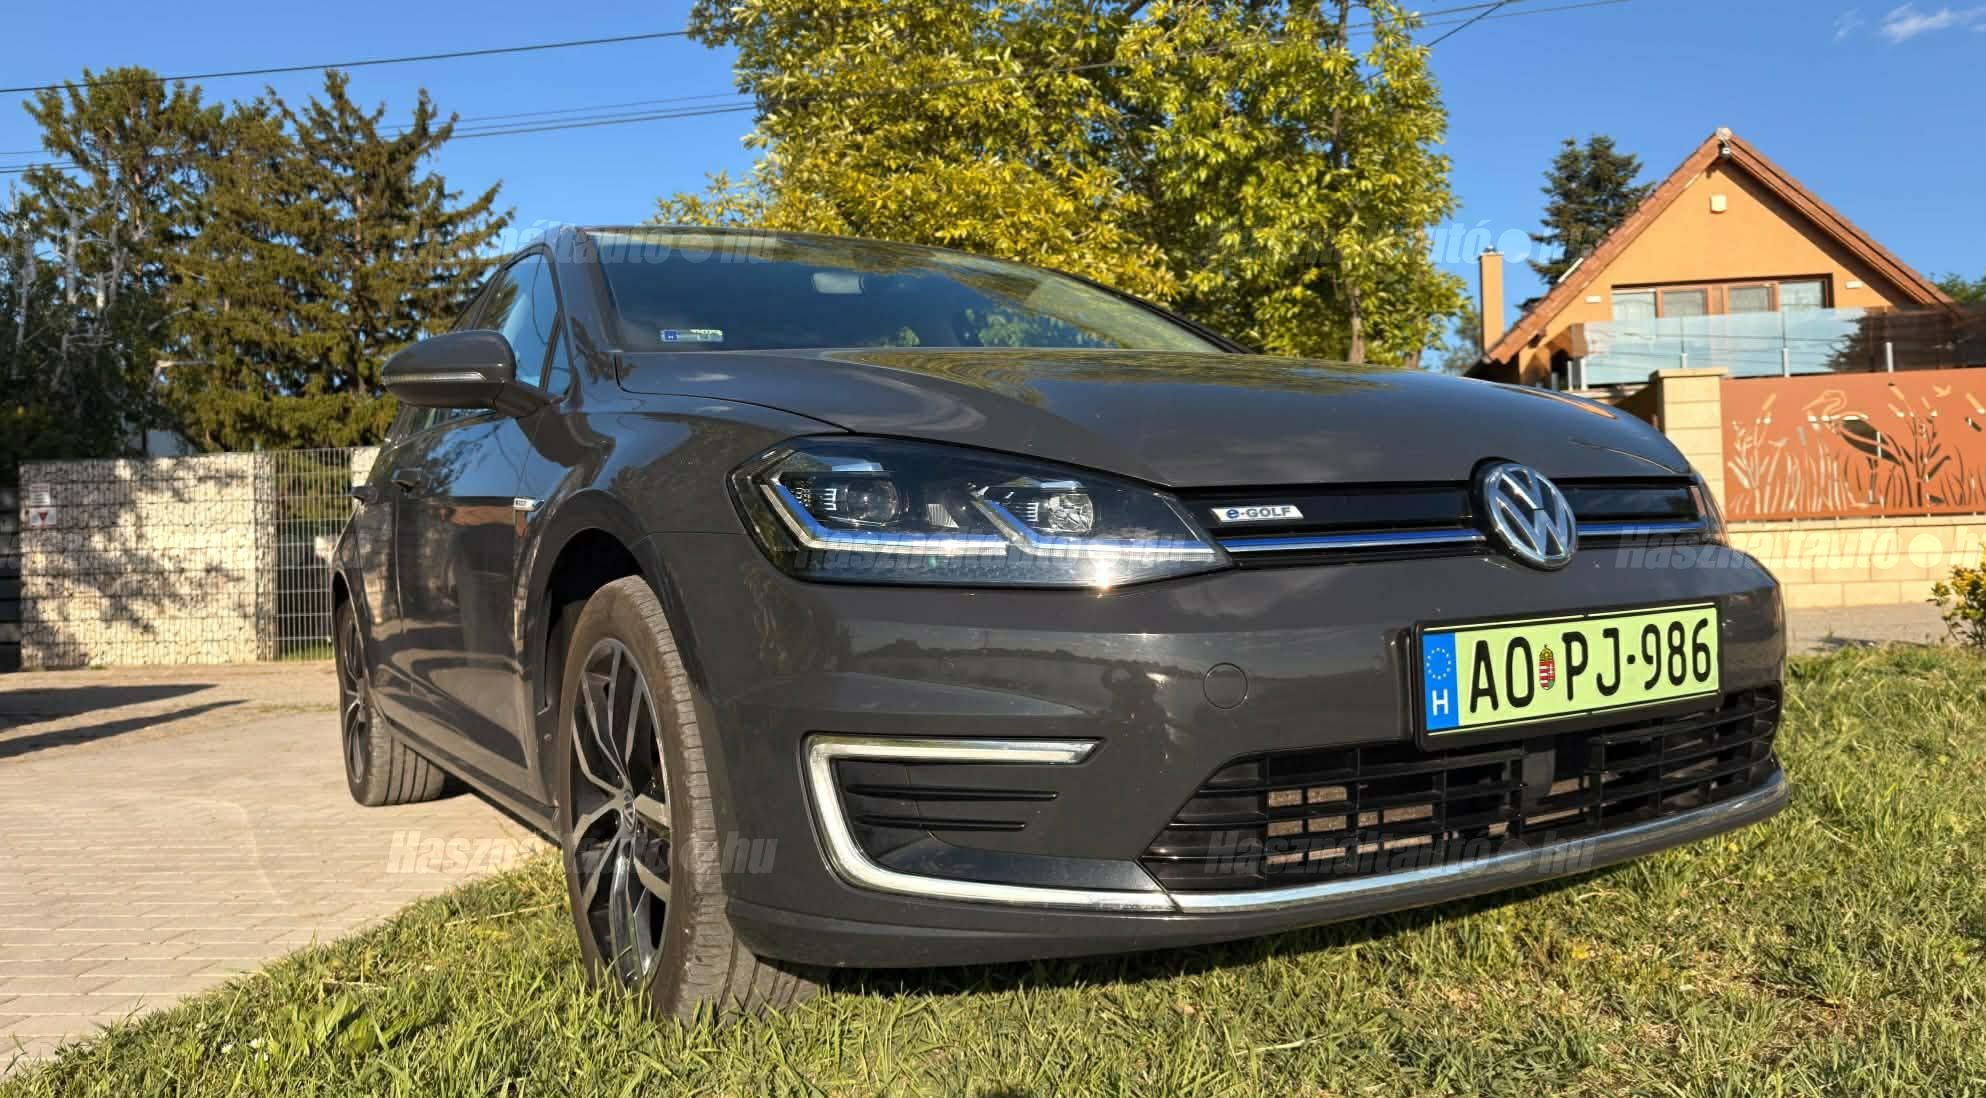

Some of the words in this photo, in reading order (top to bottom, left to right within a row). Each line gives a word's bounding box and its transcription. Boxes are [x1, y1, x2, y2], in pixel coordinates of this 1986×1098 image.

[1226, 506, 1291, 519] e-GOLF
[1432, 689, 1449, 716] H
[1470, 635, 1536, 714] AO
